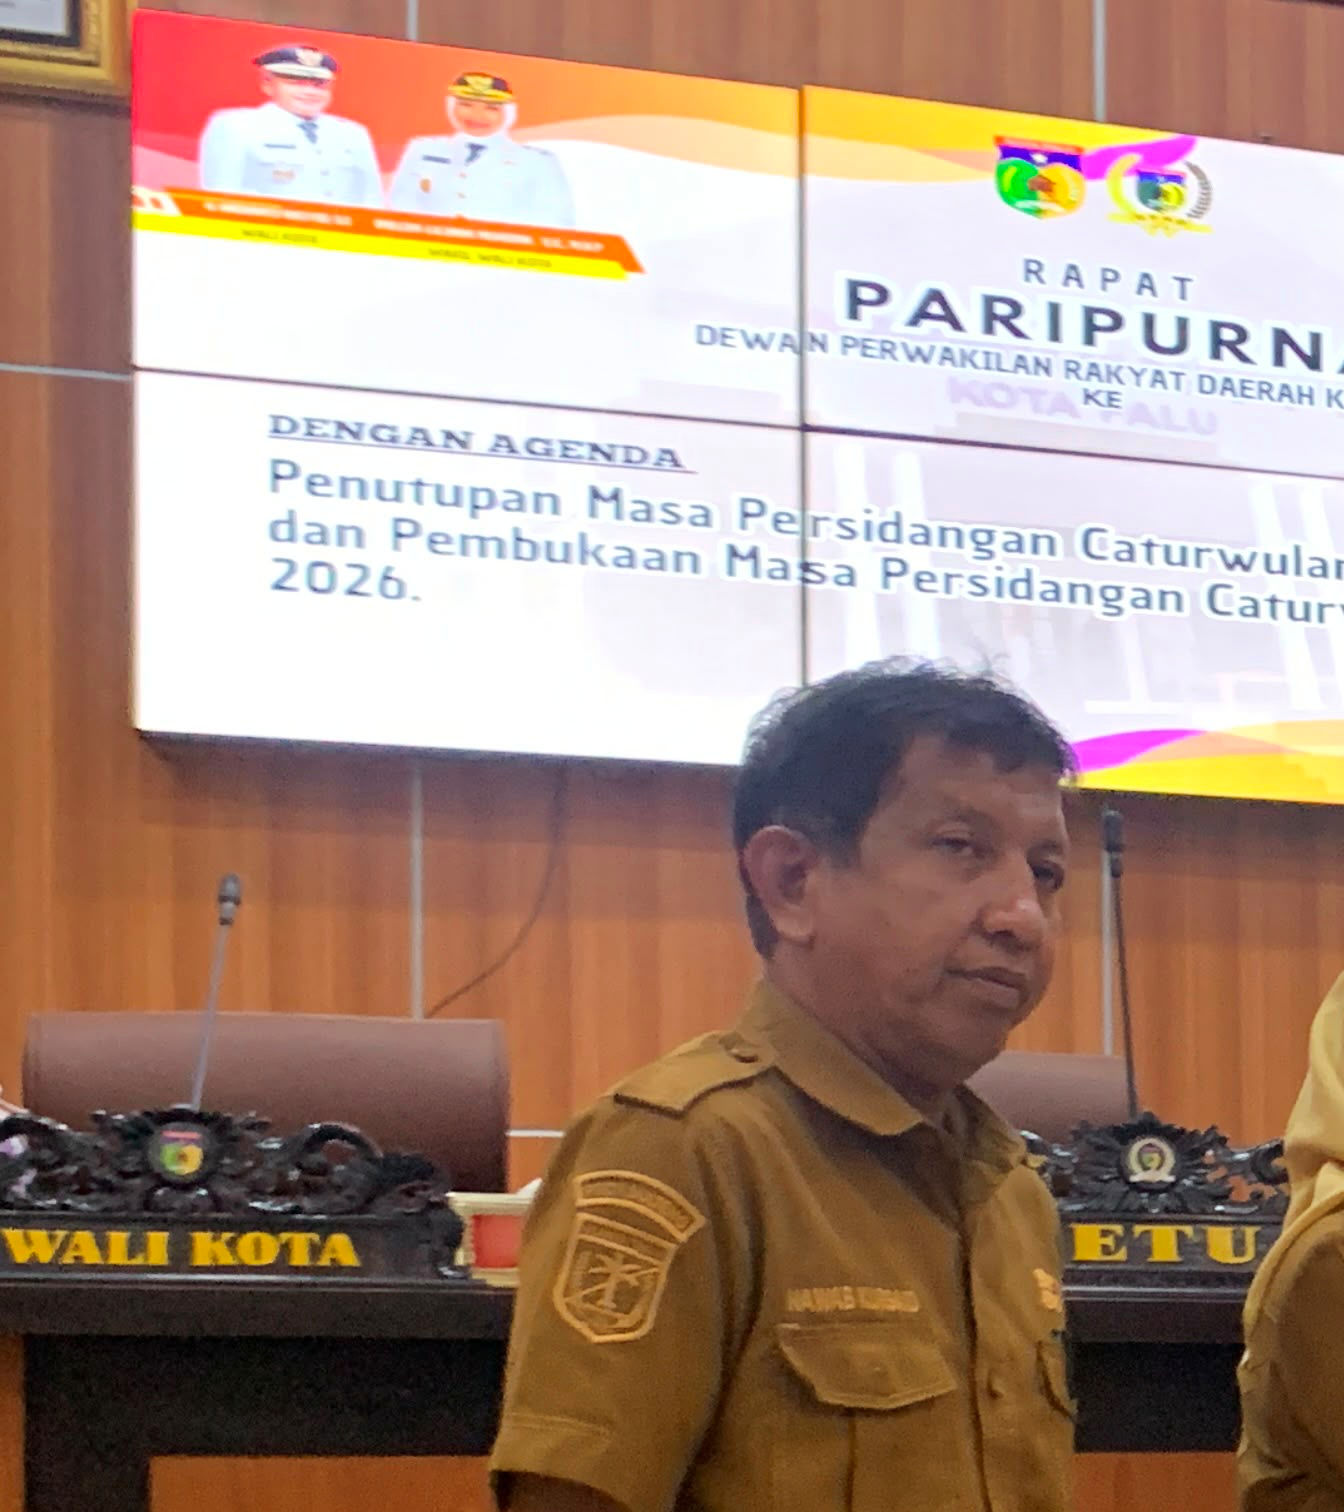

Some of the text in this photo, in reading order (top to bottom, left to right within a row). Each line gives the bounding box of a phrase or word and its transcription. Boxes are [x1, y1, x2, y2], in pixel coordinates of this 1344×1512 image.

[1023, 258, 1193, 300] RAPAT
[696, 324, 828, 356] DEWAN
[841, 335, 1051, 378] PERWAKILAN
[1064, 359, 1187, 393] RAKYAT
[1199, 374, 1315, 408] DAERAH
[1083, 387, 1123, 410] KE
[268, 414, 686, 469] DENGAN AGENDA
[270, 458, 562, 519] Penutupan
[588, 485, 714, 529] Masa
[740, 497, 1057, 561] Persidangan
[268, 509, 365, 549] dan
[391, 518, 701, 575] Pembukaan
[726, 543, 856, 588] Masa
[881, 557, 1186, 617] Persidangan
[270, 558, 422, 601] 2026.
[1, 1229, 361, 1268] WALI KOTA
[1069, 1223, 1262, 1265] ETU
